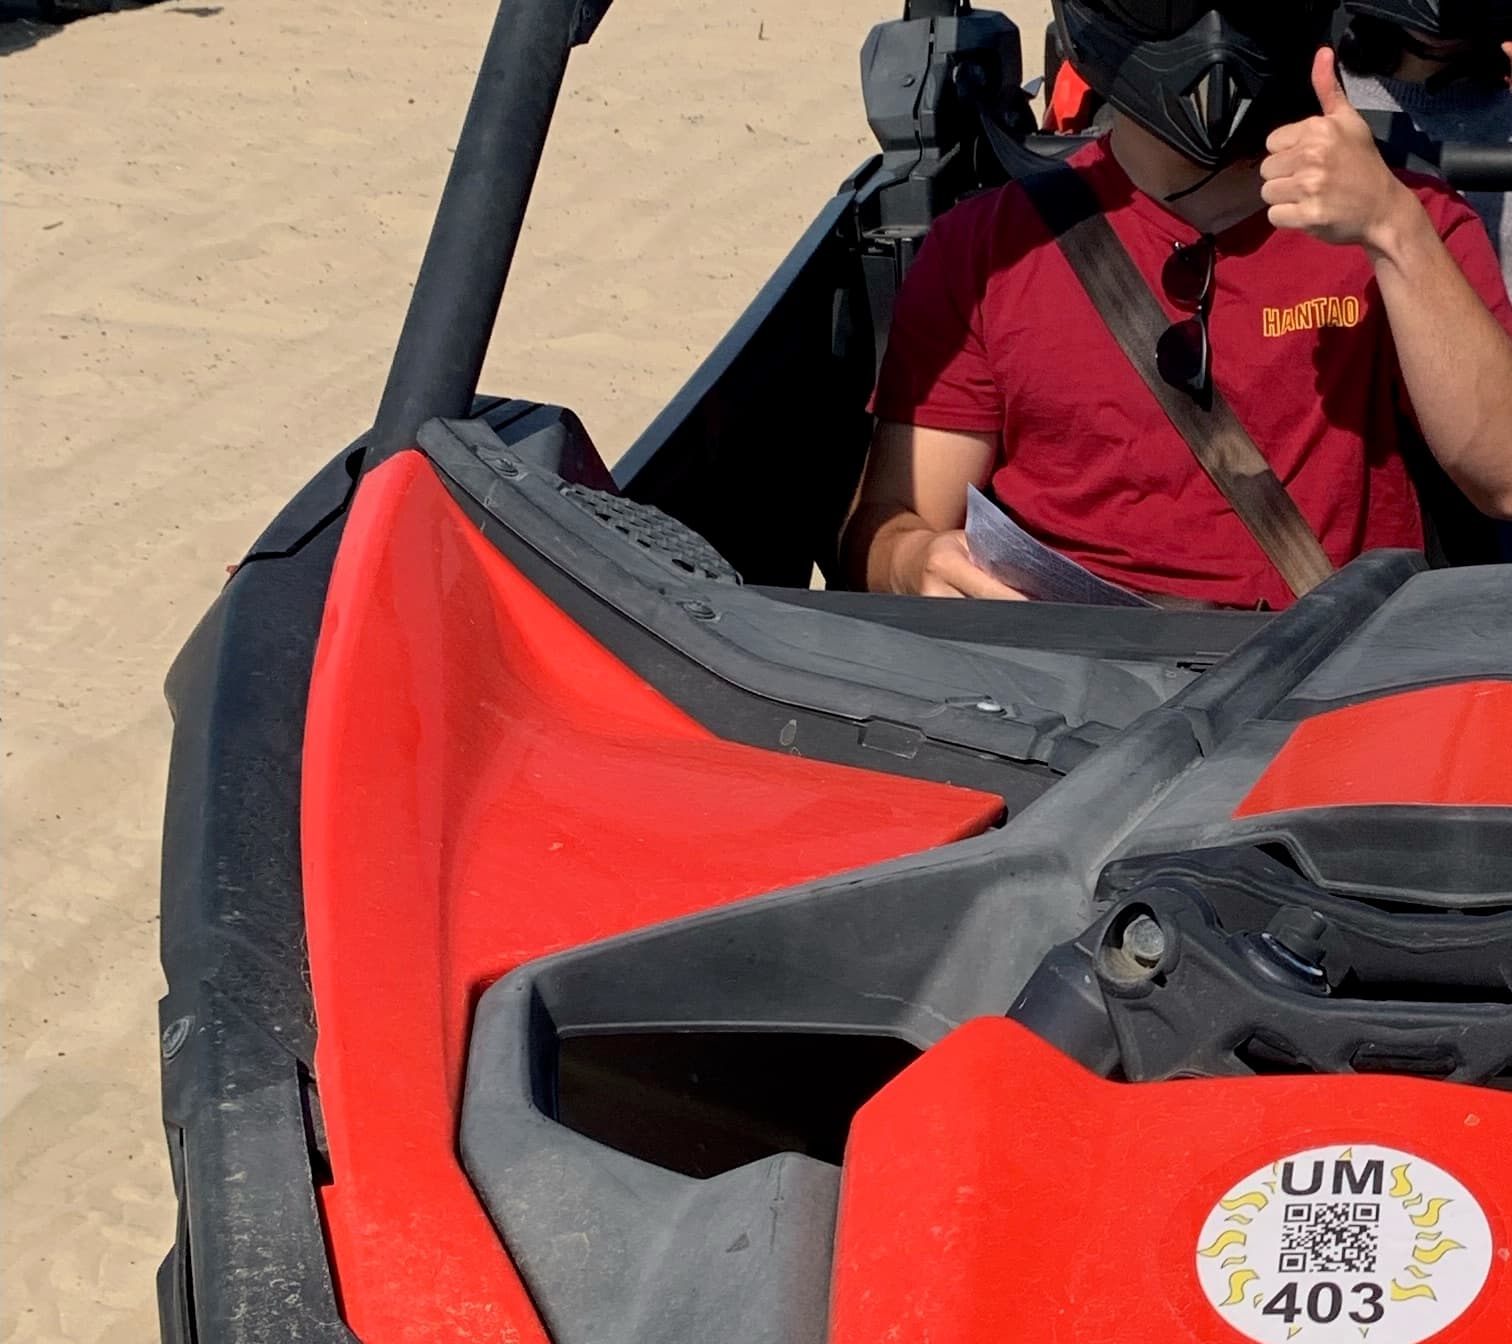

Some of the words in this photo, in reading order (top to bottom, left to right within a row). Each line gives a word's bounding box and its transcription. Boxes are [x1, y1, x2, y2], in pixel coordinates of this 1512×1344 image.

[1263, 296, 1360, 337] HANTAO
[1281, 1159, 1385, 1196] UM
[1262, 1281, 1385, 1324] 403
